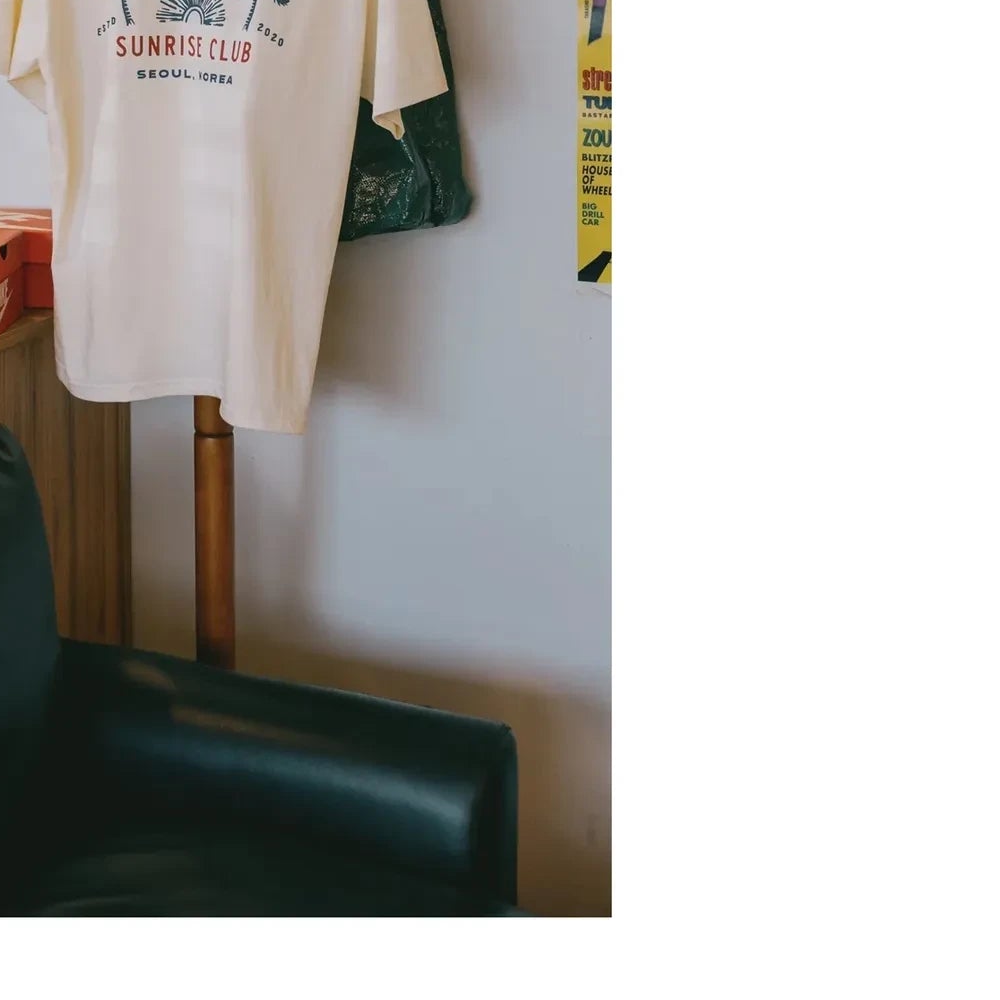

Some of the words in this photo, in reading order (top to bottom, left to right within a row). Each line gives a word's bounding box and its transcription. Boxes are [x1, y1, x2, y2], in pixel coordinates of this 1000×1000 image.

[97, 16, 117, 36] ESTD
[257, 23, 285, 48] 2020
[116, 35, 202, 58] SUNRISE
[210, 38, 252, 63] CLUB
[137, 69, 195, 81] SEOUL,
[582, 175, 594, 184] OF
[582, 211, 604, 219] DRILL
[582, 218, 599, 226] CAR
